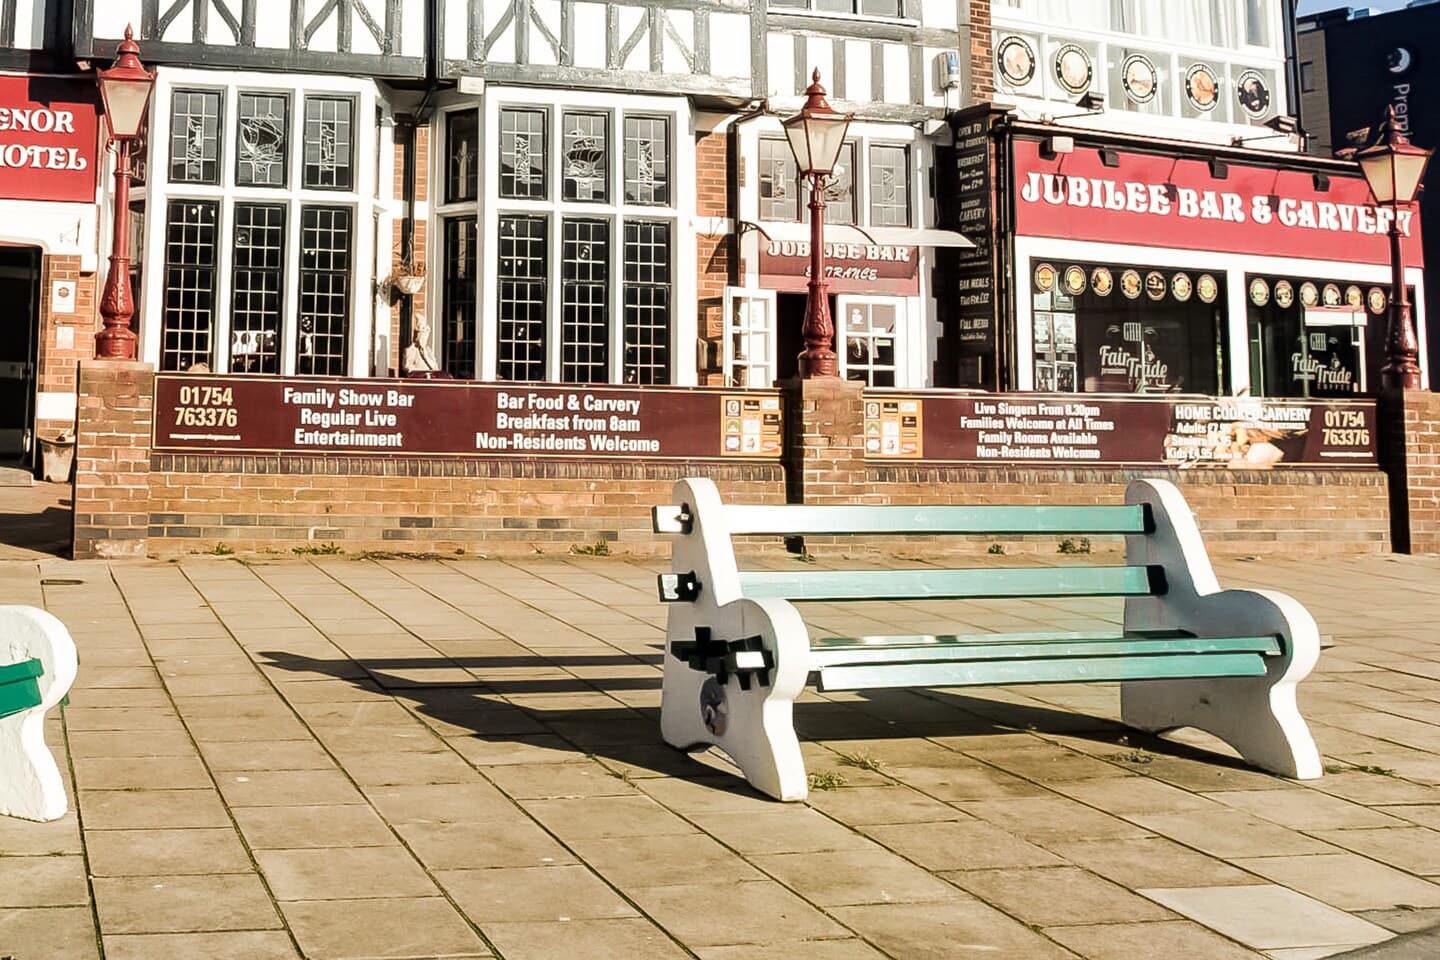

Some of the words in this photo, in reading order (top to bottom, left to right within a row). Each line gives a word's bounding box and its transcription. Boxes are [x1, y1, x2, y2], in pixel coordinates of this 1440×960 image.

[1393, 83, 1413, 144] Premi
[1021, 172, 1171, 215] JUBILEE
[1177, 187, 1245, 223] BAR
[1252, 195, 1272, 224] &
[1278, 198, 1412, 237] CARVERY
[767, 240, 864, 259] JUBEE
[866, 245, 910, 261] BAR
[805, 266, 878, 280] ETRANCE
[1100, 345, 1130, 366] Fair
[1291, 353, 1319, 372] Fair
[1127, 358, 1168, 378] Trade
[1315, 364, 1352, 384] Trade
[180, 386, 233, 406] 01754
[284, 387, 335, 408] Family
[339, 390, 383, 407] Show
[387, 391, 415, 407] Bar
[497, 392, 525, 409] Bar
[528, 393, 564, 410] Food
[567, 394, 580, 411] &
[584, 394, 641, 416] Carvery
[174, 406, 238, 427] 763376
[301, 408, 362, 428] Regular
[365, 410, 396, 427] Live
[974, 402, 997, 415] Live
[998, 402, 1037, 417] Singers
[1038, 403, 1064, 416] From
[1175, 405, 1212, 420] HOME
[1261, 407, 1312, 422] CARVERY
[1324, 411, 1364, 428] 01754
[496, 412, 569, 430] Breakfast
[572, 414, 607, 431] from
[609, 415, 641, 432] 8am
[960, 416, 1004, 429] Families
[1006, 417, 1054, 430] Welcome
[1056, 418, 1067, 430] at
[1068, 418, 1083, 430] All
[1084, 418, 1115, 431] Times
[294, 428, 403, 447] Entertainment
[476, 432, 587, 451] Non-Residents
[589, 434, 660, 452] Welcome
[978, 431, 1013, 446] Family
[1014, 432, 1049, 444] Rooms
[1049, 432, 1098, 445] Available
[1322, 428, 1370, 446] 763376
[976, 445, 1051, 458] Non-Residents
[1052, 446, 1101, 459] Welcome
